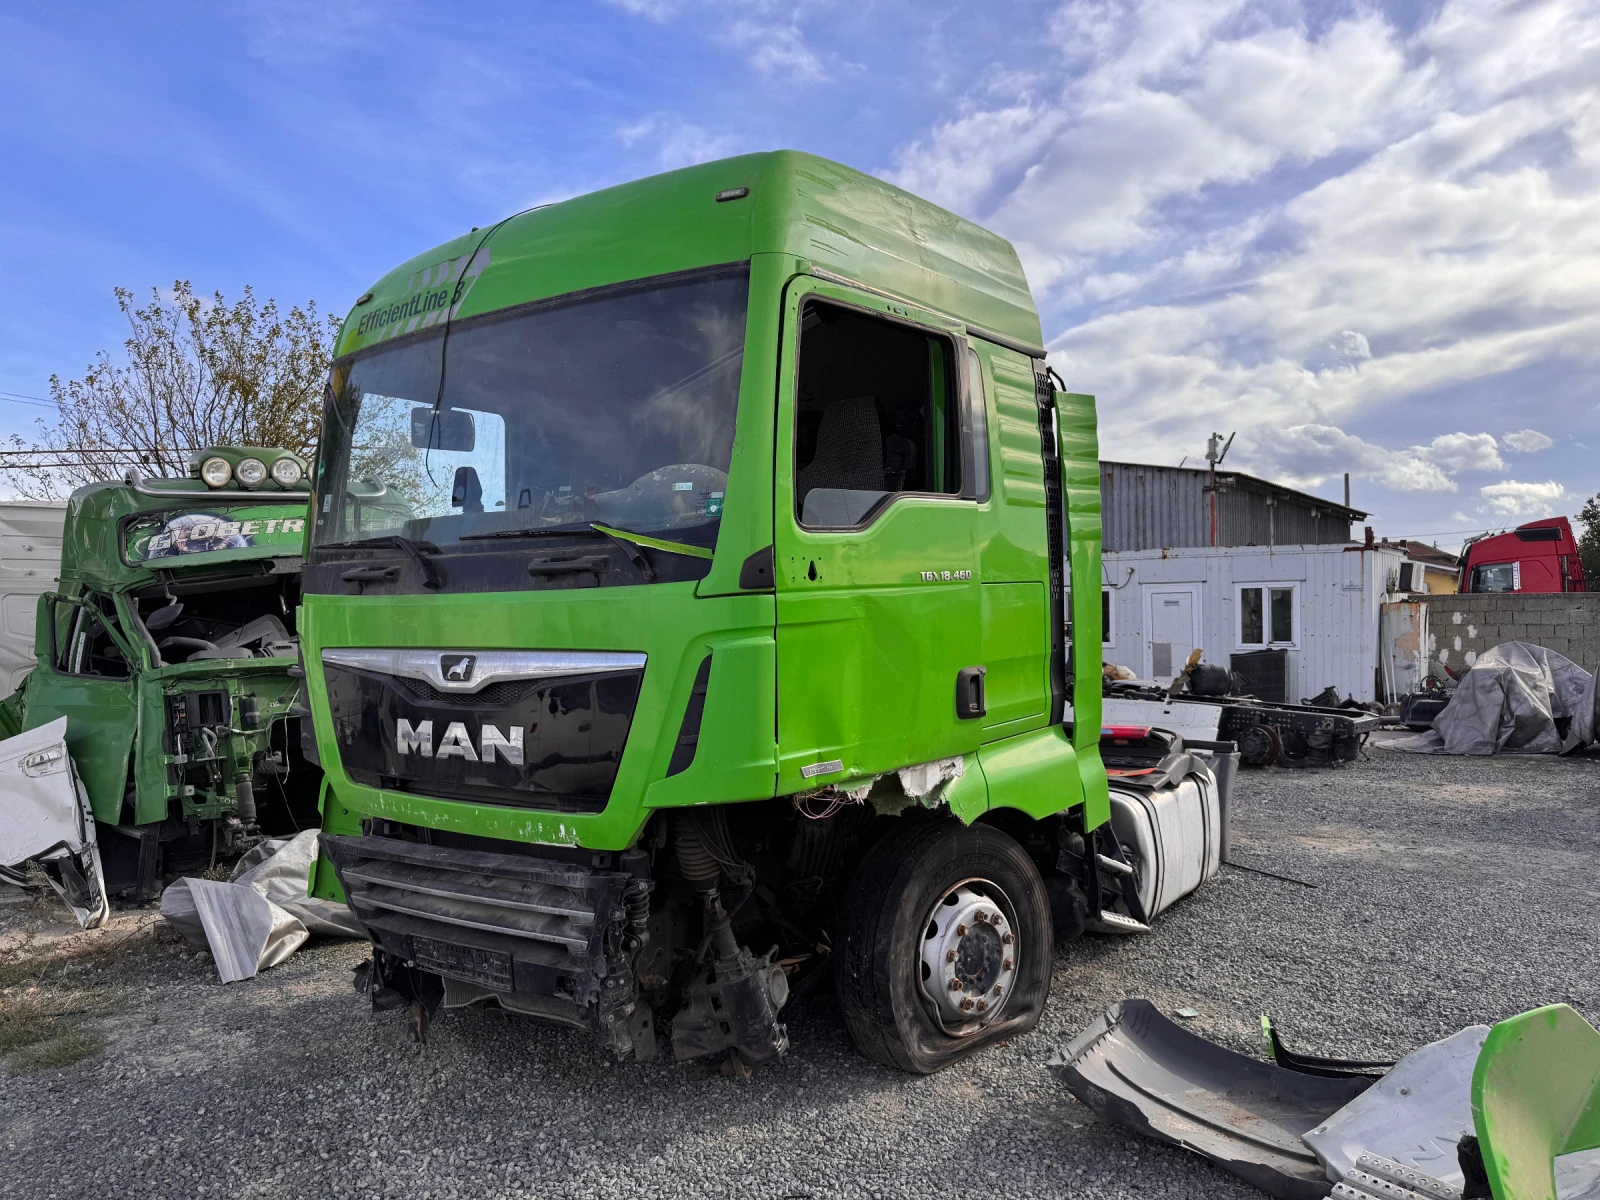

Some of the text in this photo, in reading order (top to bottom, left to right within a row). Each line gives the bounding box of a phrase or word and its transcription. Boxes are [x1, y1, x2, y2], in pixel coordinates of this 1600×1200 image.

[357, 288, 448, 336] EfficientLine
[940, 570, 972, 582] 18.460
[397, 718, 524, 765] MAN
